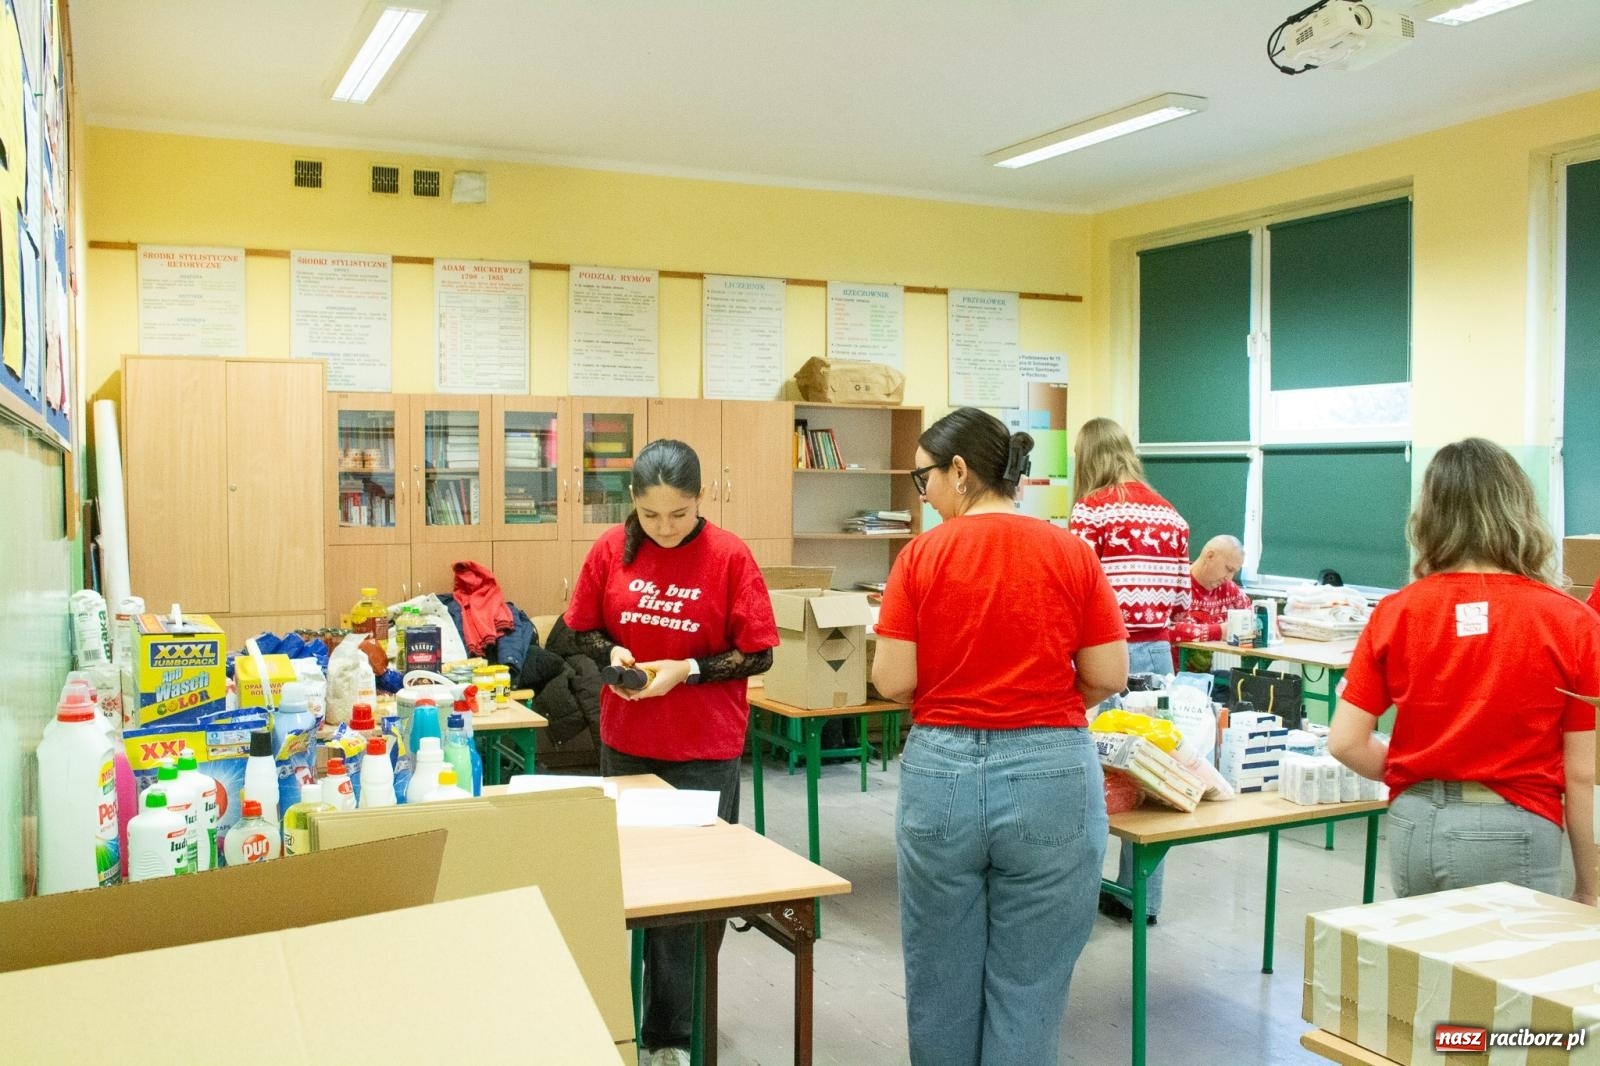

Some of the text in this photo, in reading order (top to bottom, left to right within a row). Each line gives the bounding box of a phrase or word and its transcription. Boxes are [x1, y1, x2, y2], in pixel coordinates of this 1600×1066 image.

[179, 252, 239, 262] STYLISTYCZNE
[441, 264, 523, 274] ADAM MICKIEWICZ
[628, 578, 702, 600] Ok, but
[637, 594, 684, 614] first
[619, 610, 701, 633] presents
[155, 643, 216, 659] XXXL
[153, 658, 216, 667] JUMBOPACK
[155, 671, 210, 703] Wasch
[157, 690, 210, 715] COLOR
[243, 839, 269, 862] pur
